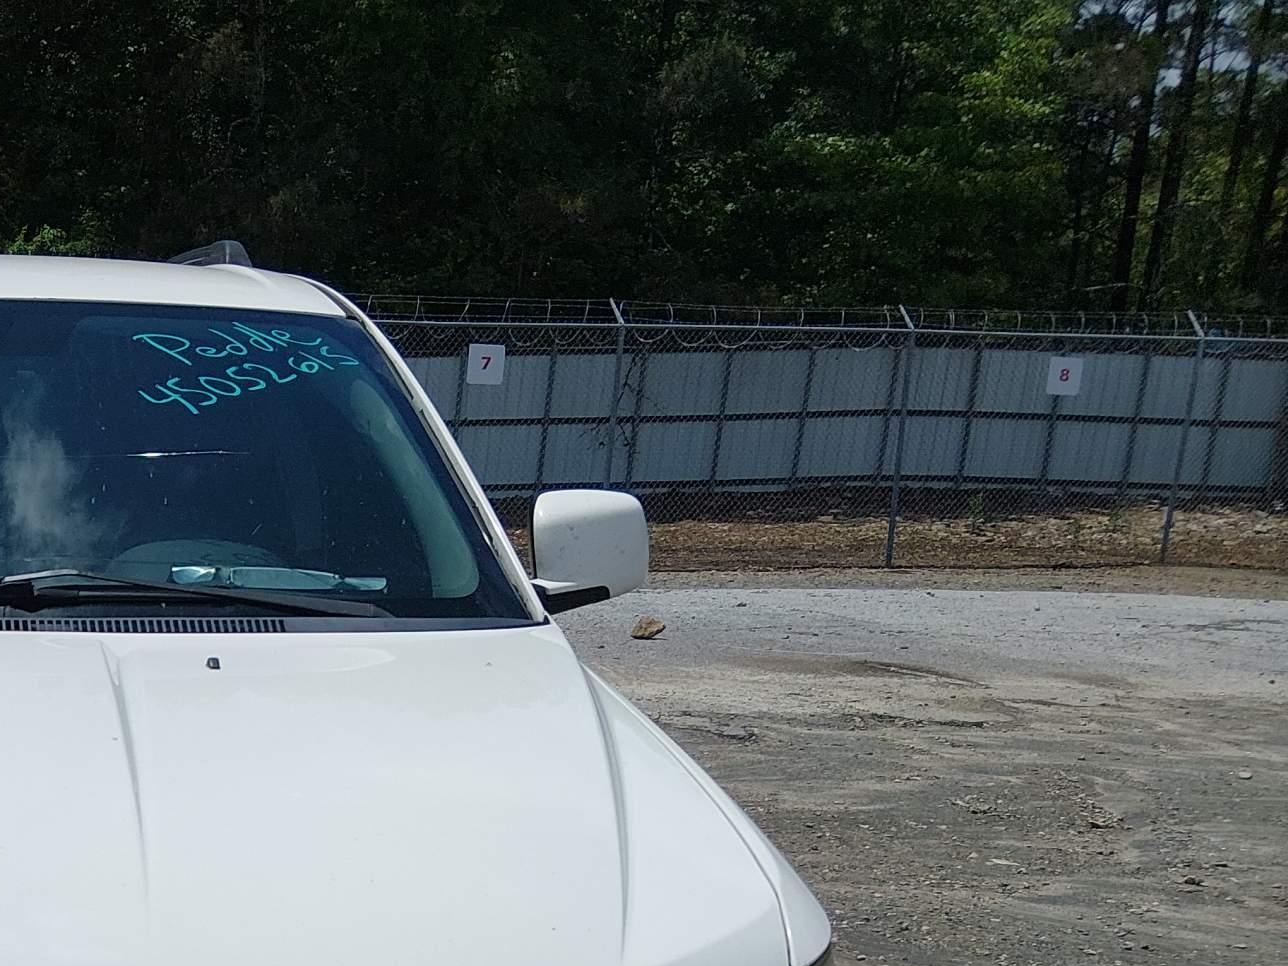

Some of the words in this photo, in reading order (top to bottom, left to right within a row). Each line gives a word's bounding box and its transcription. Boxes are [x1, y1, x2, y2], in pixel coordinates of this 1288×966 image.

[132, 321, 323, 366] Peddle
[480, 356, 492, 370] 7
[1059, 368, 1071, 382] 8
[137, 346, 361, 415] 45052615
